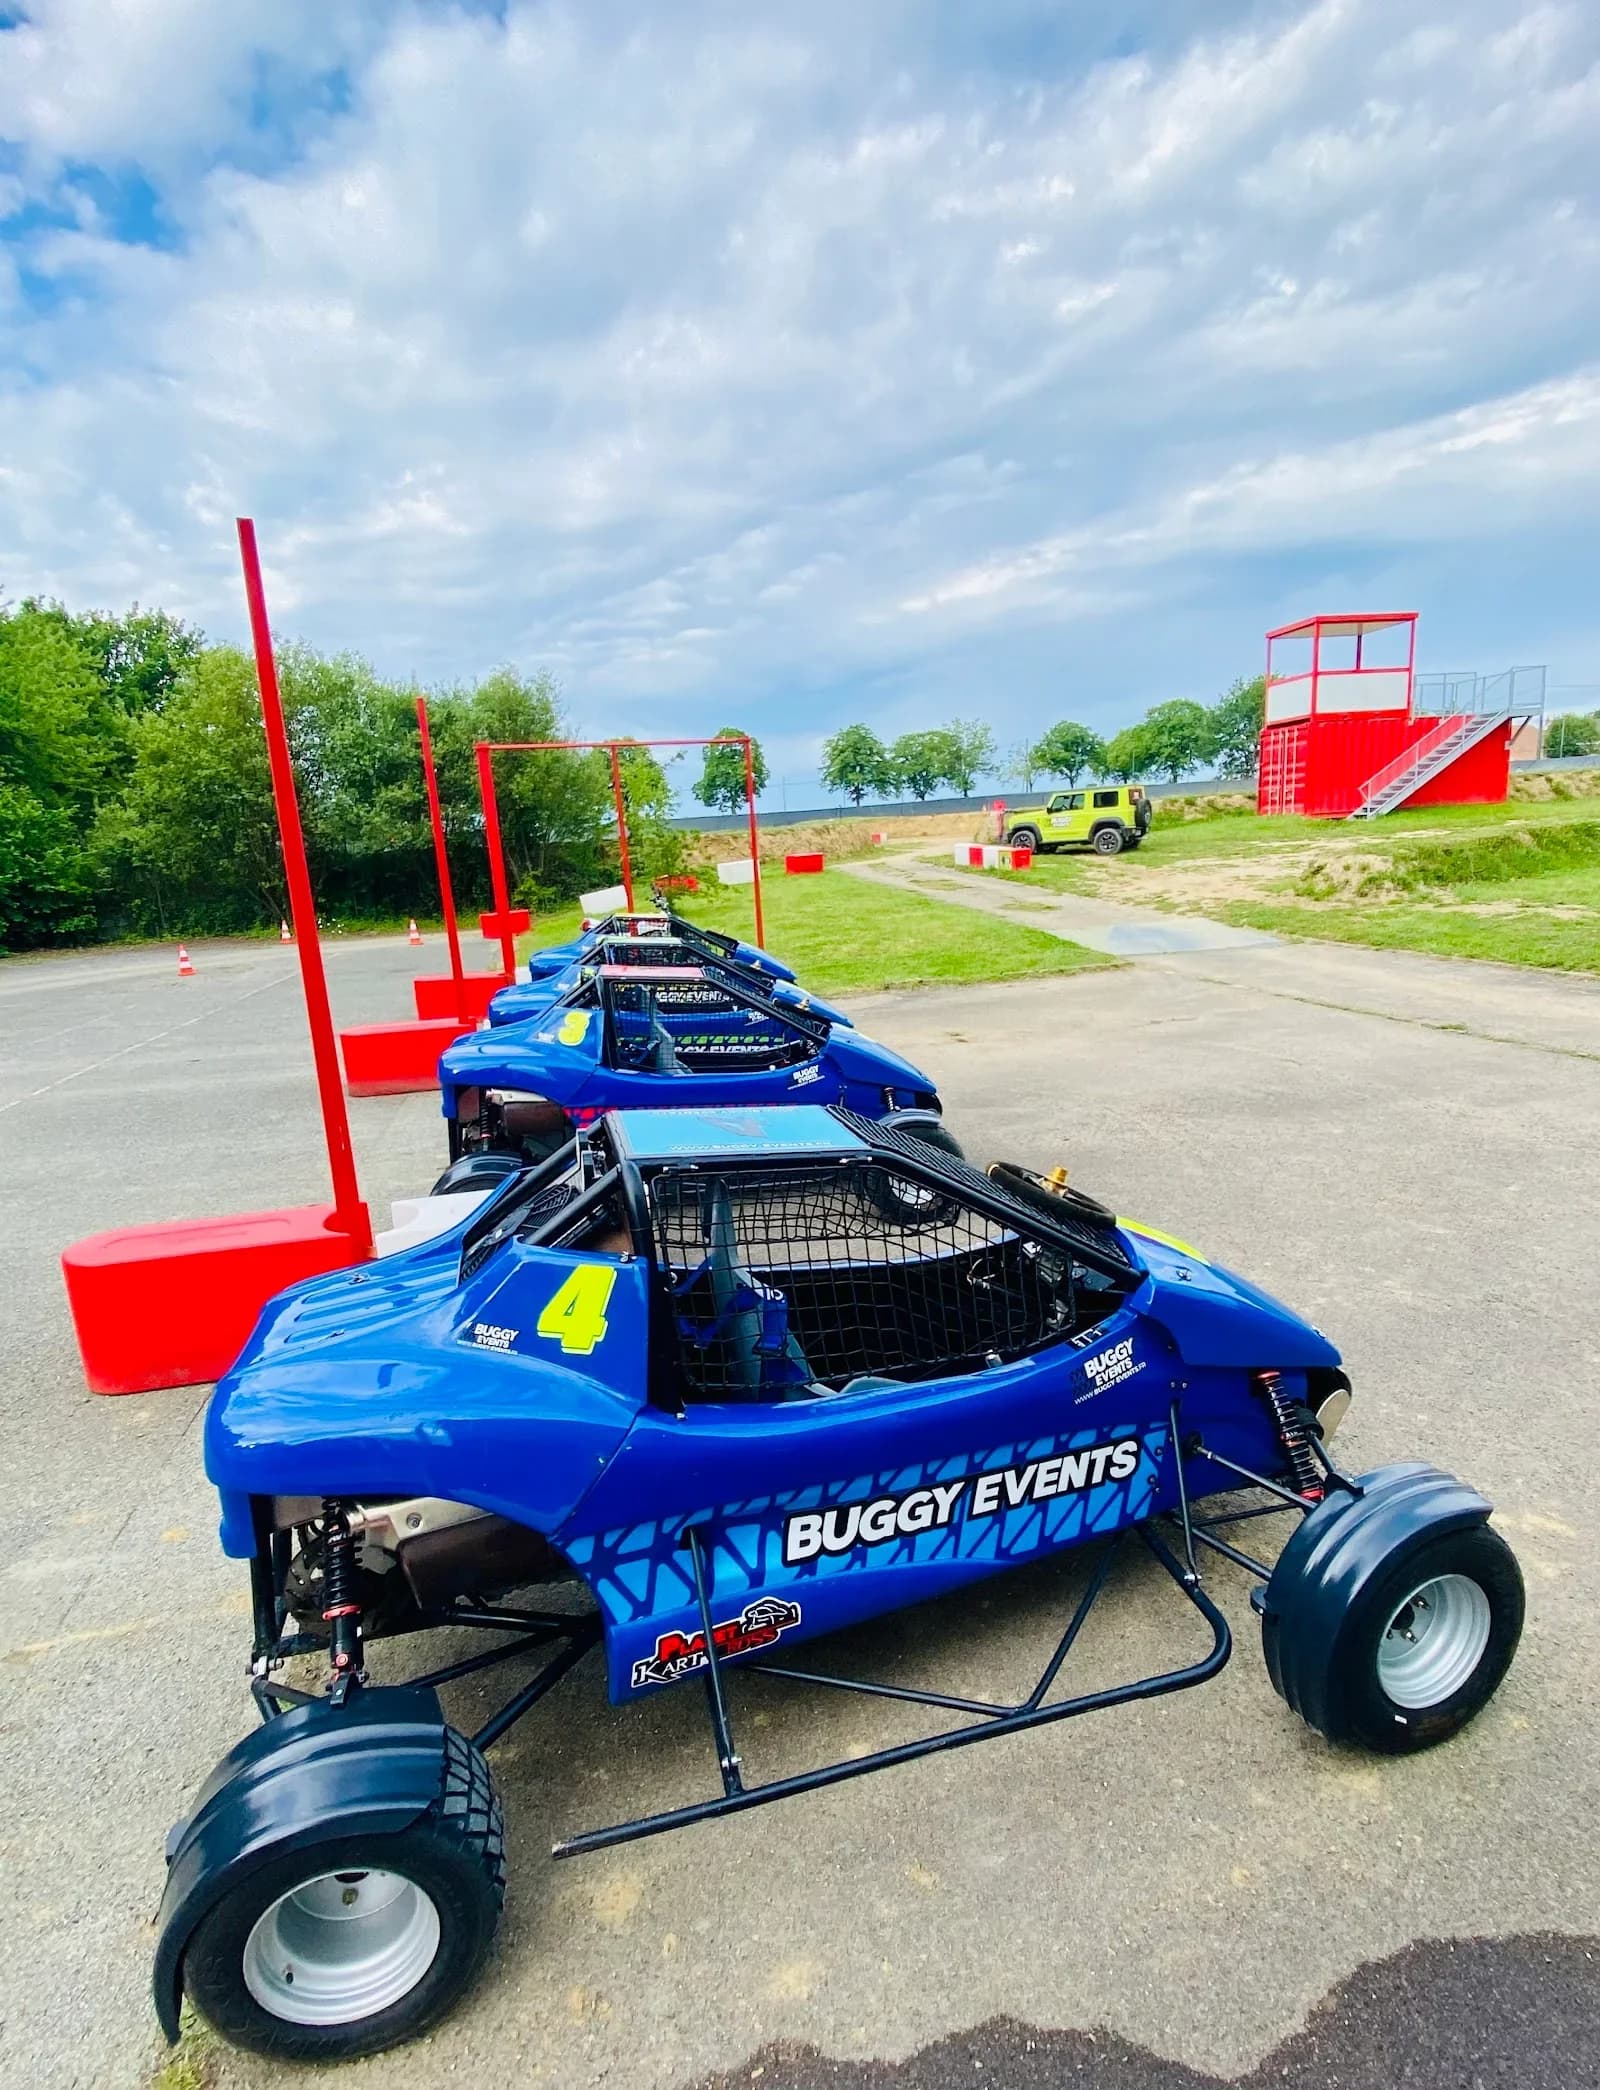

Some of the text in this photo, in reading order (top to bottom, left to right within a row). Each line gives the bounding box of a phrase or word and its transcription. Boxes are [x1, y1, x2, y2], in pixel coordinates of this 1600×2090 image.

[558, 1010, 591, 1047] 3
[537, 1264, 618, 1355] 4
[474, 1322, 520, 1342] BUGGY
[476, 1334, 511, 1349] EVENTS
[1083, 1336, 1134, 1379] BUGGY
[1094, 1356, 1134, 1387] EVENTS
[786, 1440, 1138, 1562] BUGGY EVENTS
[634, 1652, 704, 1684] KART
